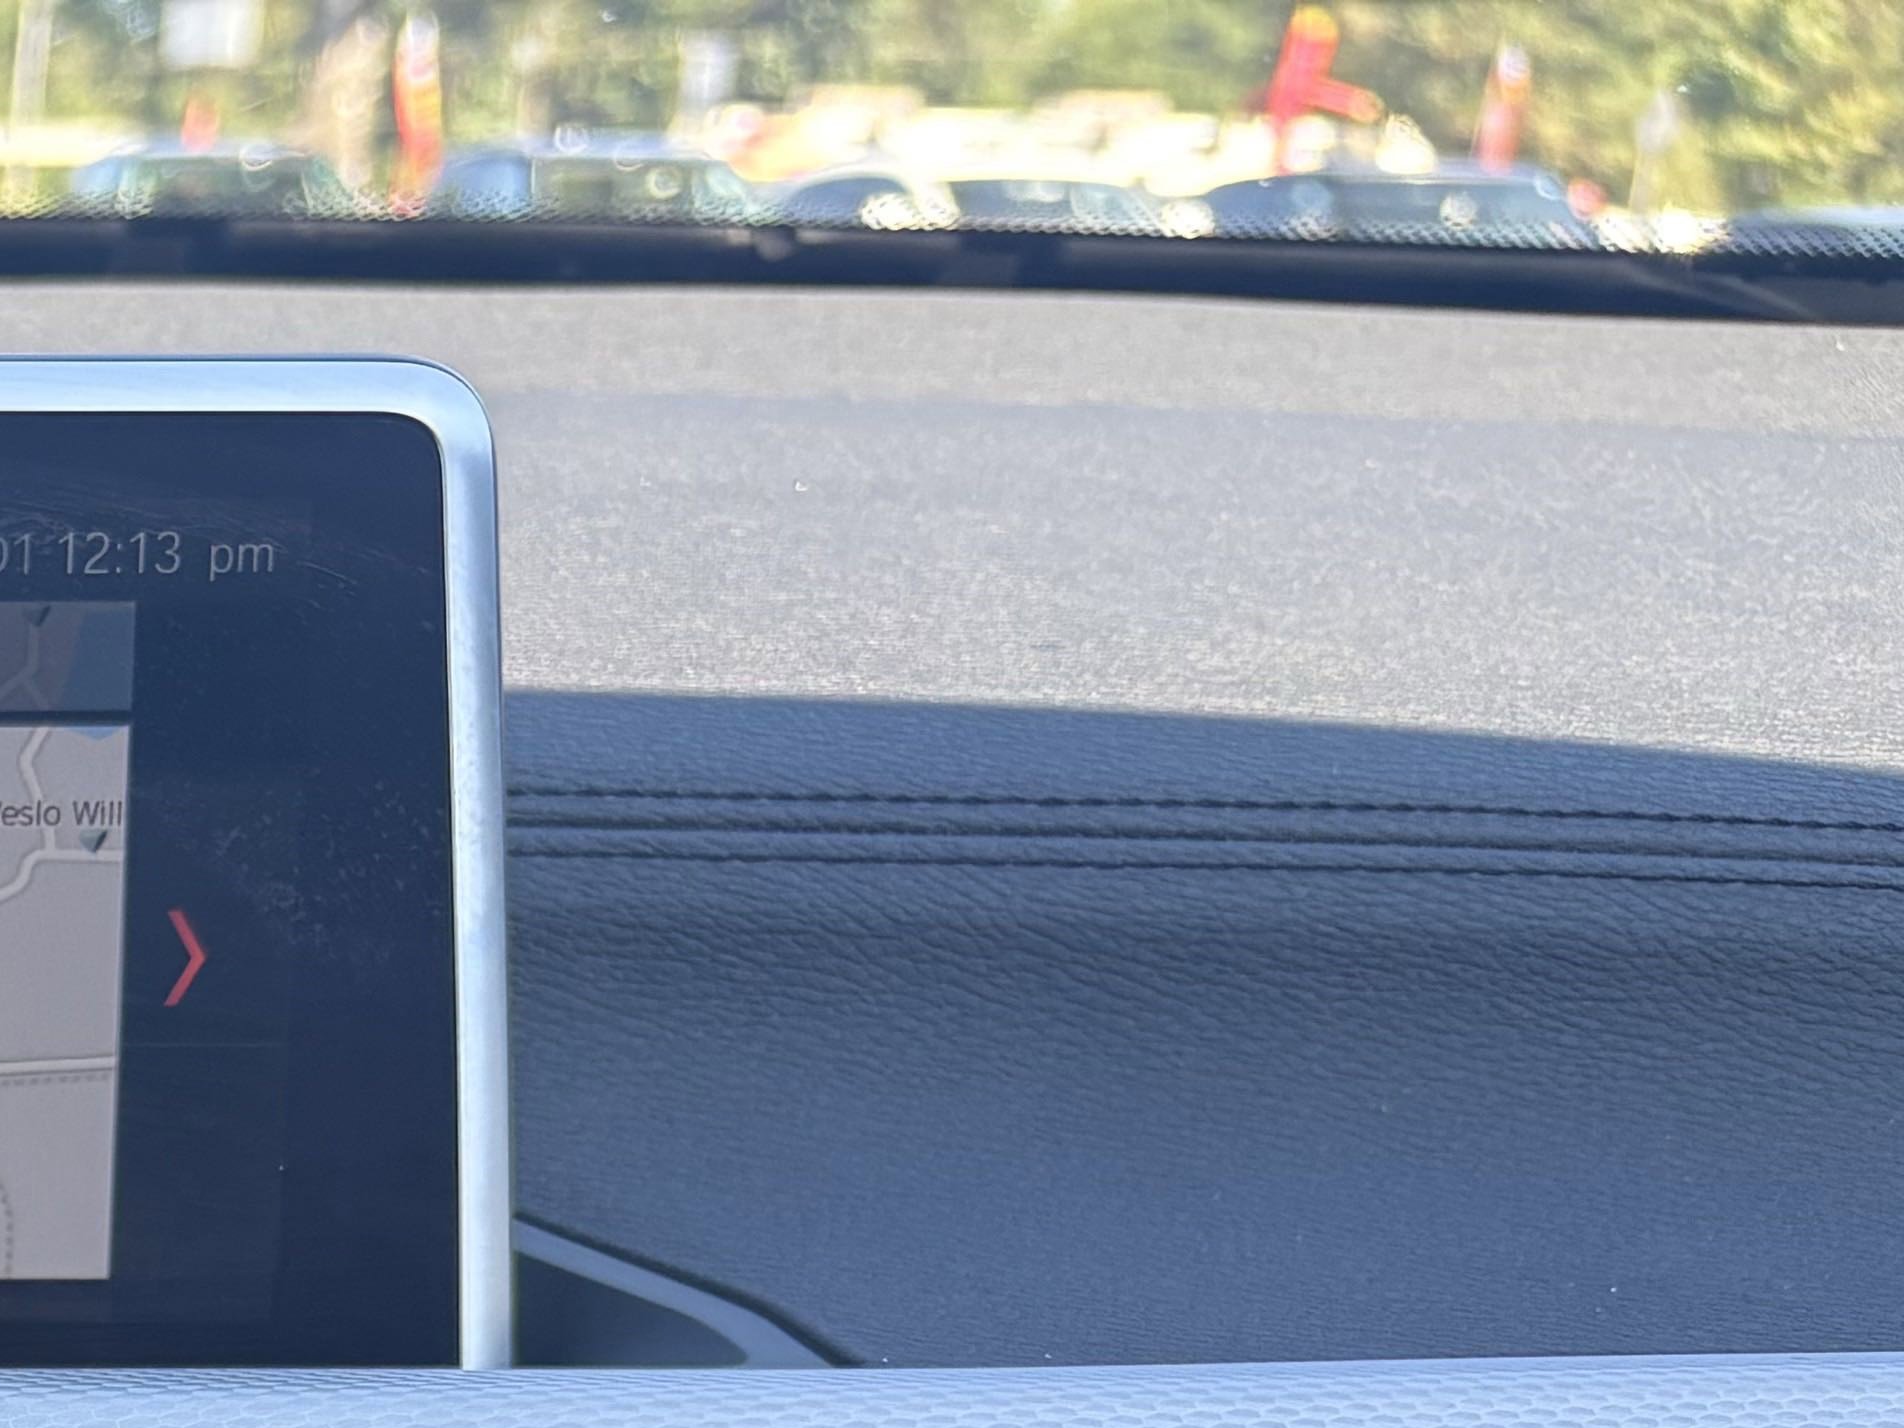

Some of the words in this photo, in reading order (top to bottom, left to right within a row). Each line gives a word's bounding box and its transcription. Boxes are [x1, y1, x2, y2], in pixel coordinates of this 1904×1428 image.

[58, 530, 181, 575] 12:13
[209, 543, 274, 582] pm
[72, 800, 123, 826] Will
